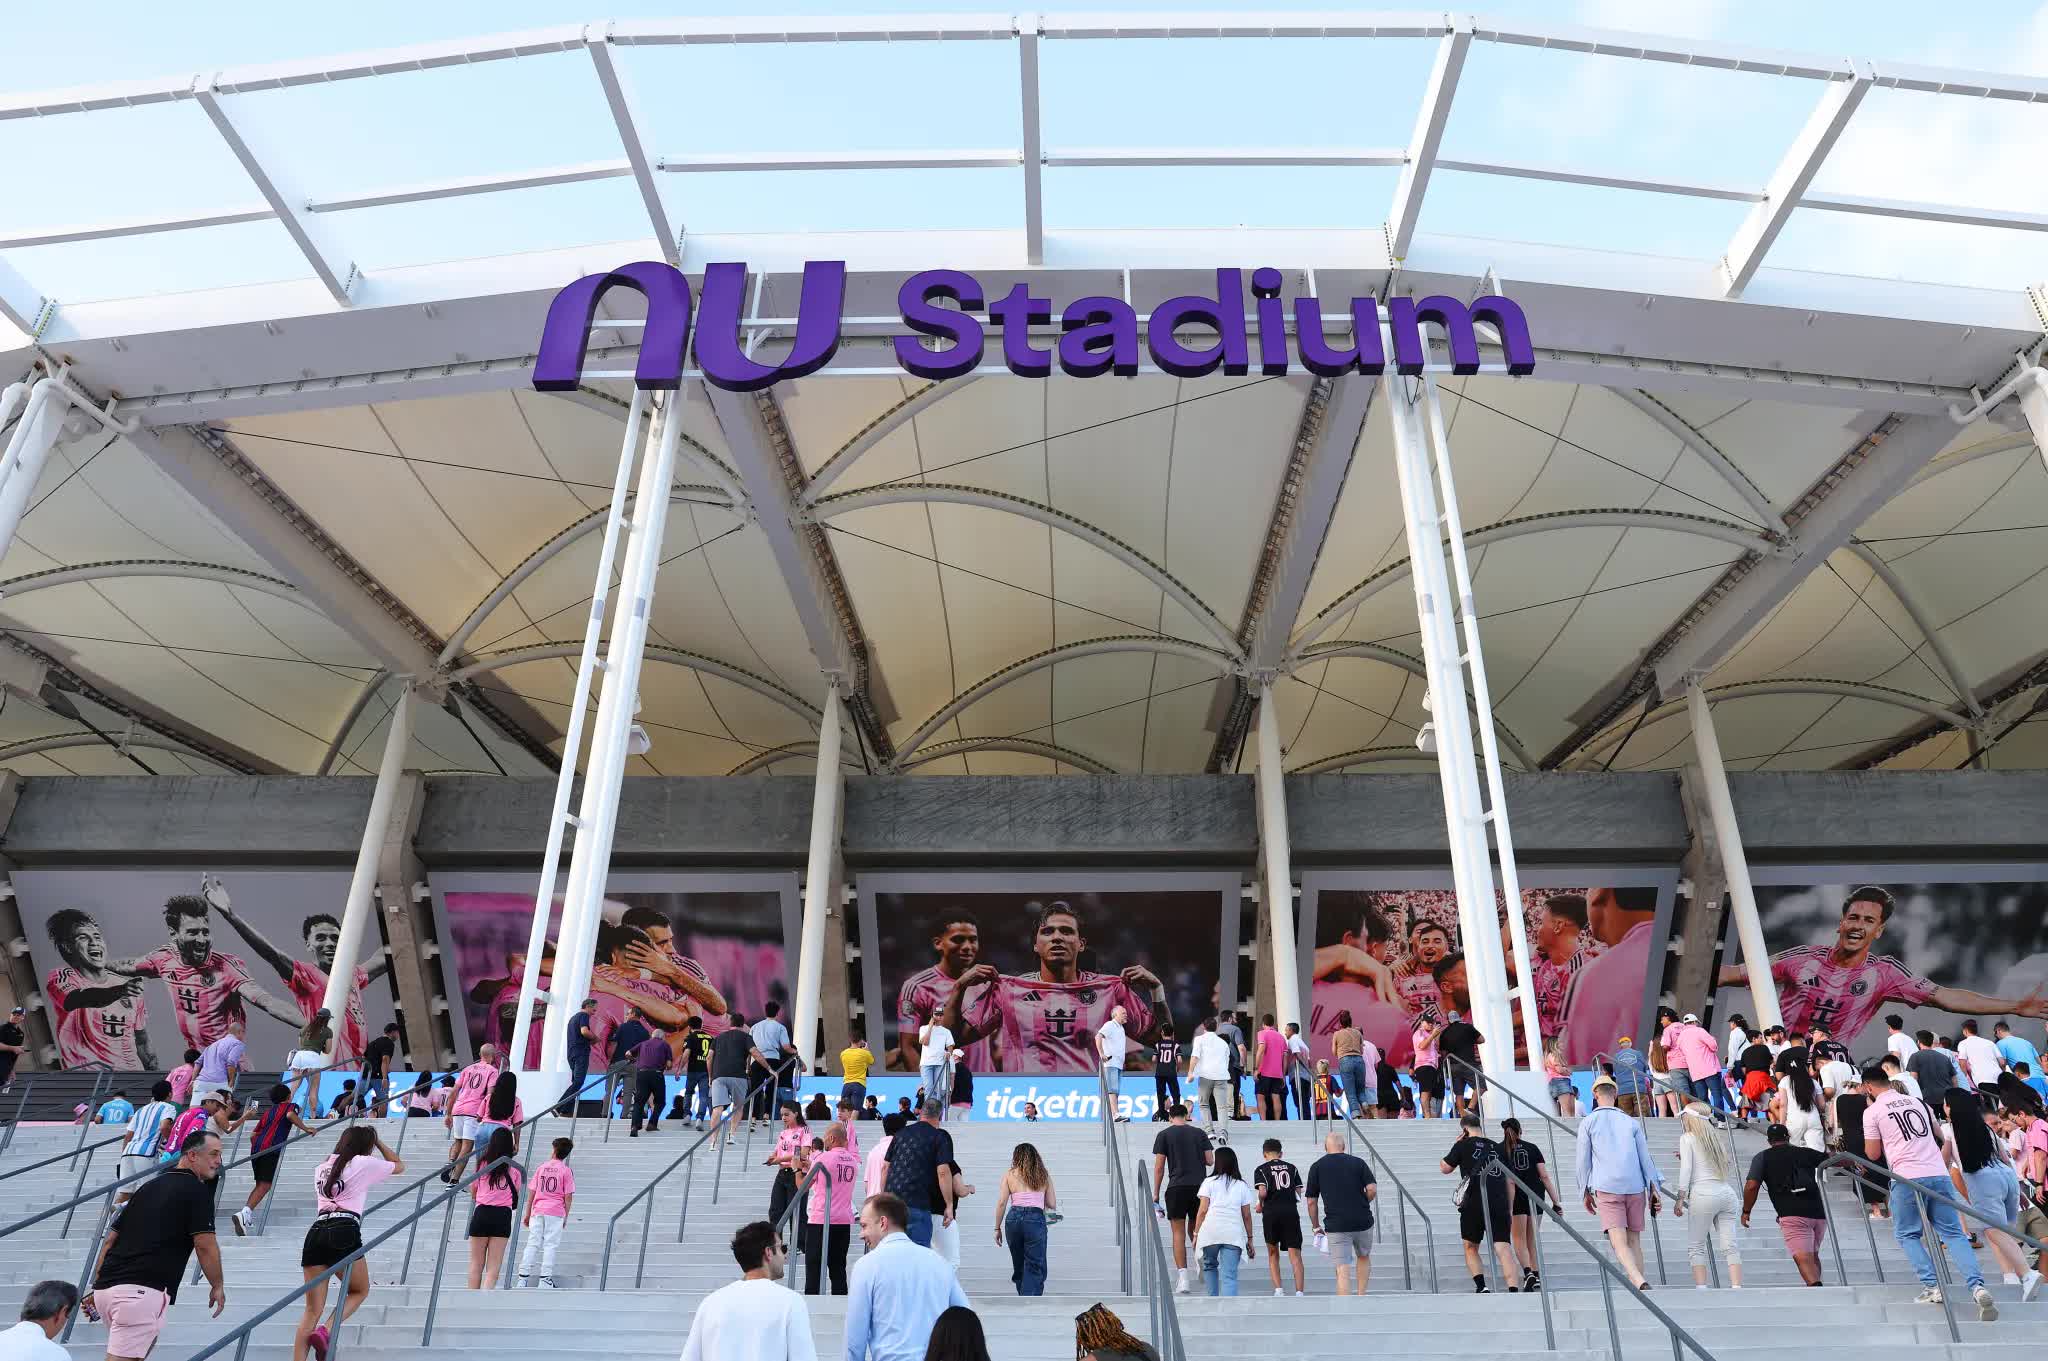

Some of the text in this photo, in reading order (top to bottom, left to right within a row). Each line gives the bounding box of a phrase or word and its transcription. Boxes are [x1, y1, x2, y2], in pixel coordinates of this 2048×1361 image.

[893, 267, 1536, 378] Stadium
[701, 1039, 709, 1056] 9
[1160, 1049, 1172, 1063] 10
[986, 1087, 1199, 1118] ticketmasr
[1886, 1099, 1912, 1109] MESSI
[1888, 1109, 1928, 1141] 10
[837, 1164, 855, 1182] 10
[1271, 1170, 1291, 1190] 10
[540, 1176, 558, 1193] 10
